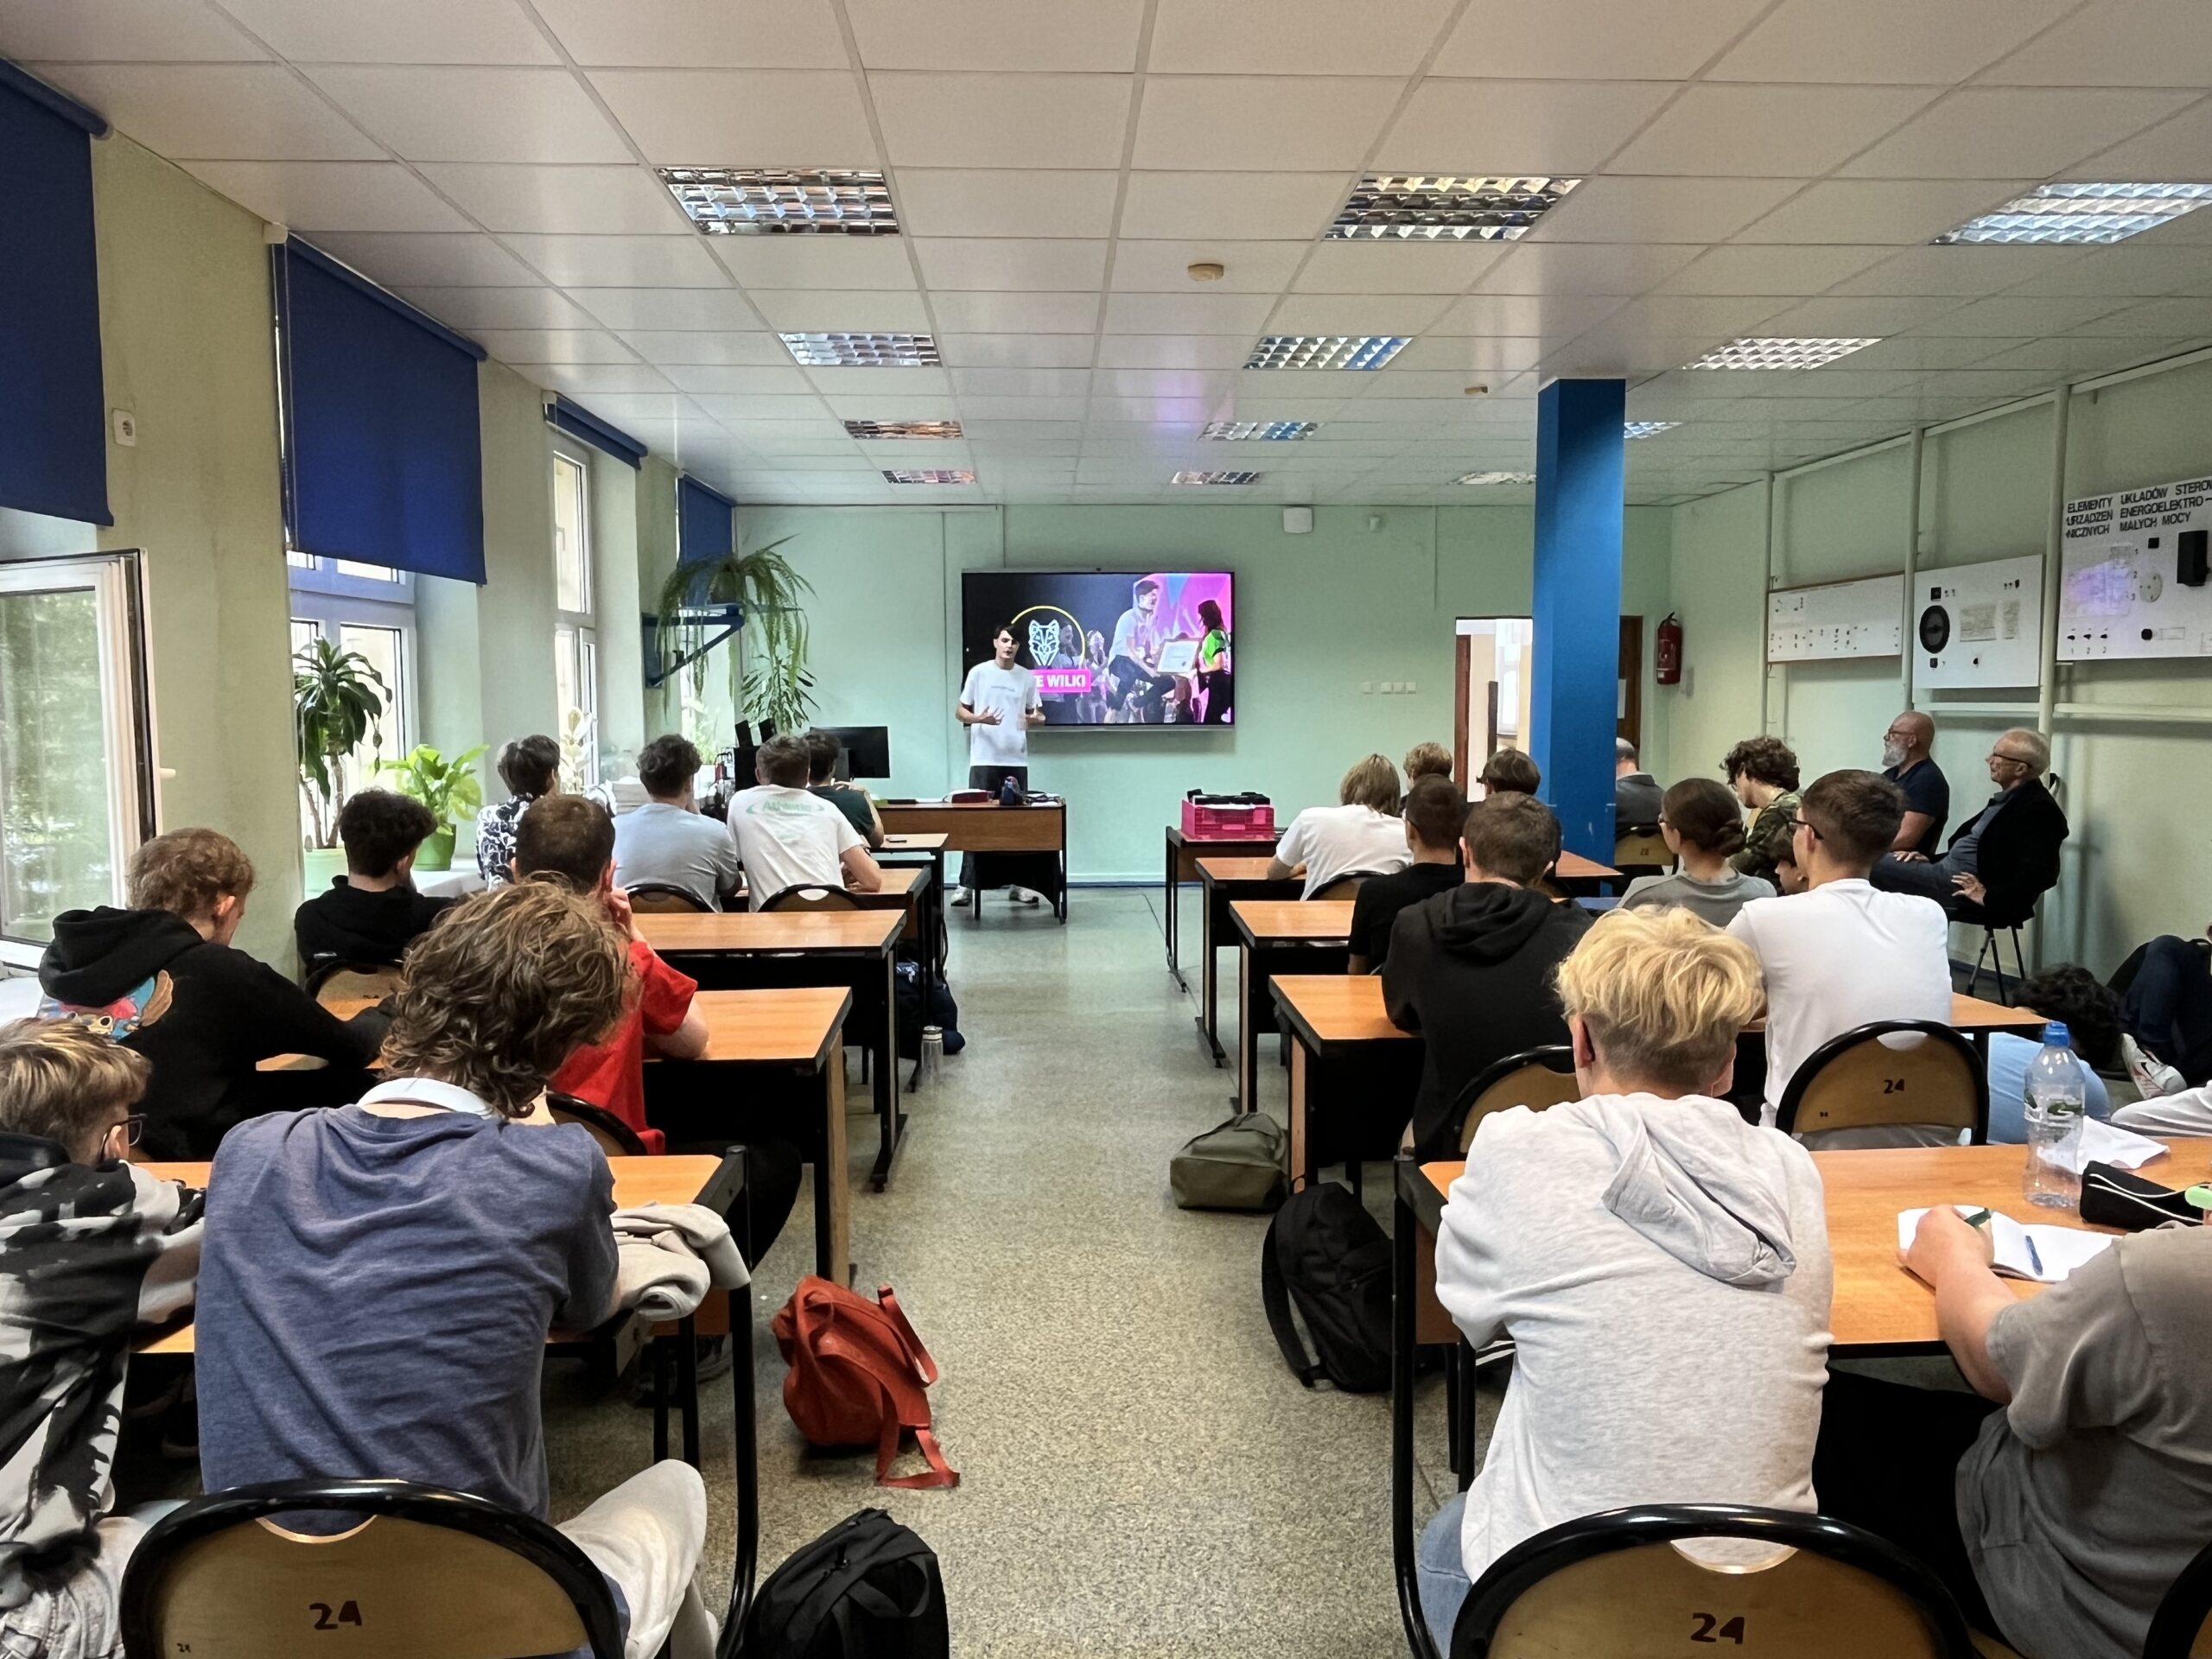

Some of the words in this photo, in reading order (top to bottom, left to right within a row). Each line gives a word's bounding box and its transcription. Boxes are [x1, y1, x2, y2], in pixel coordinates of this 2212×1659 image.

[2068, 497, 2113, 513] ELEMENTY
[2162, 512, 2191, 526] MOCY
[1034, 675, 1045, 688] E
[1046, 674, 1086, 688] WILKI
[1884, 1078, 1905, 1094] 24
[309, 1600, 363, 1630] 24
[1690, 1612, 1745, 1645] 24
